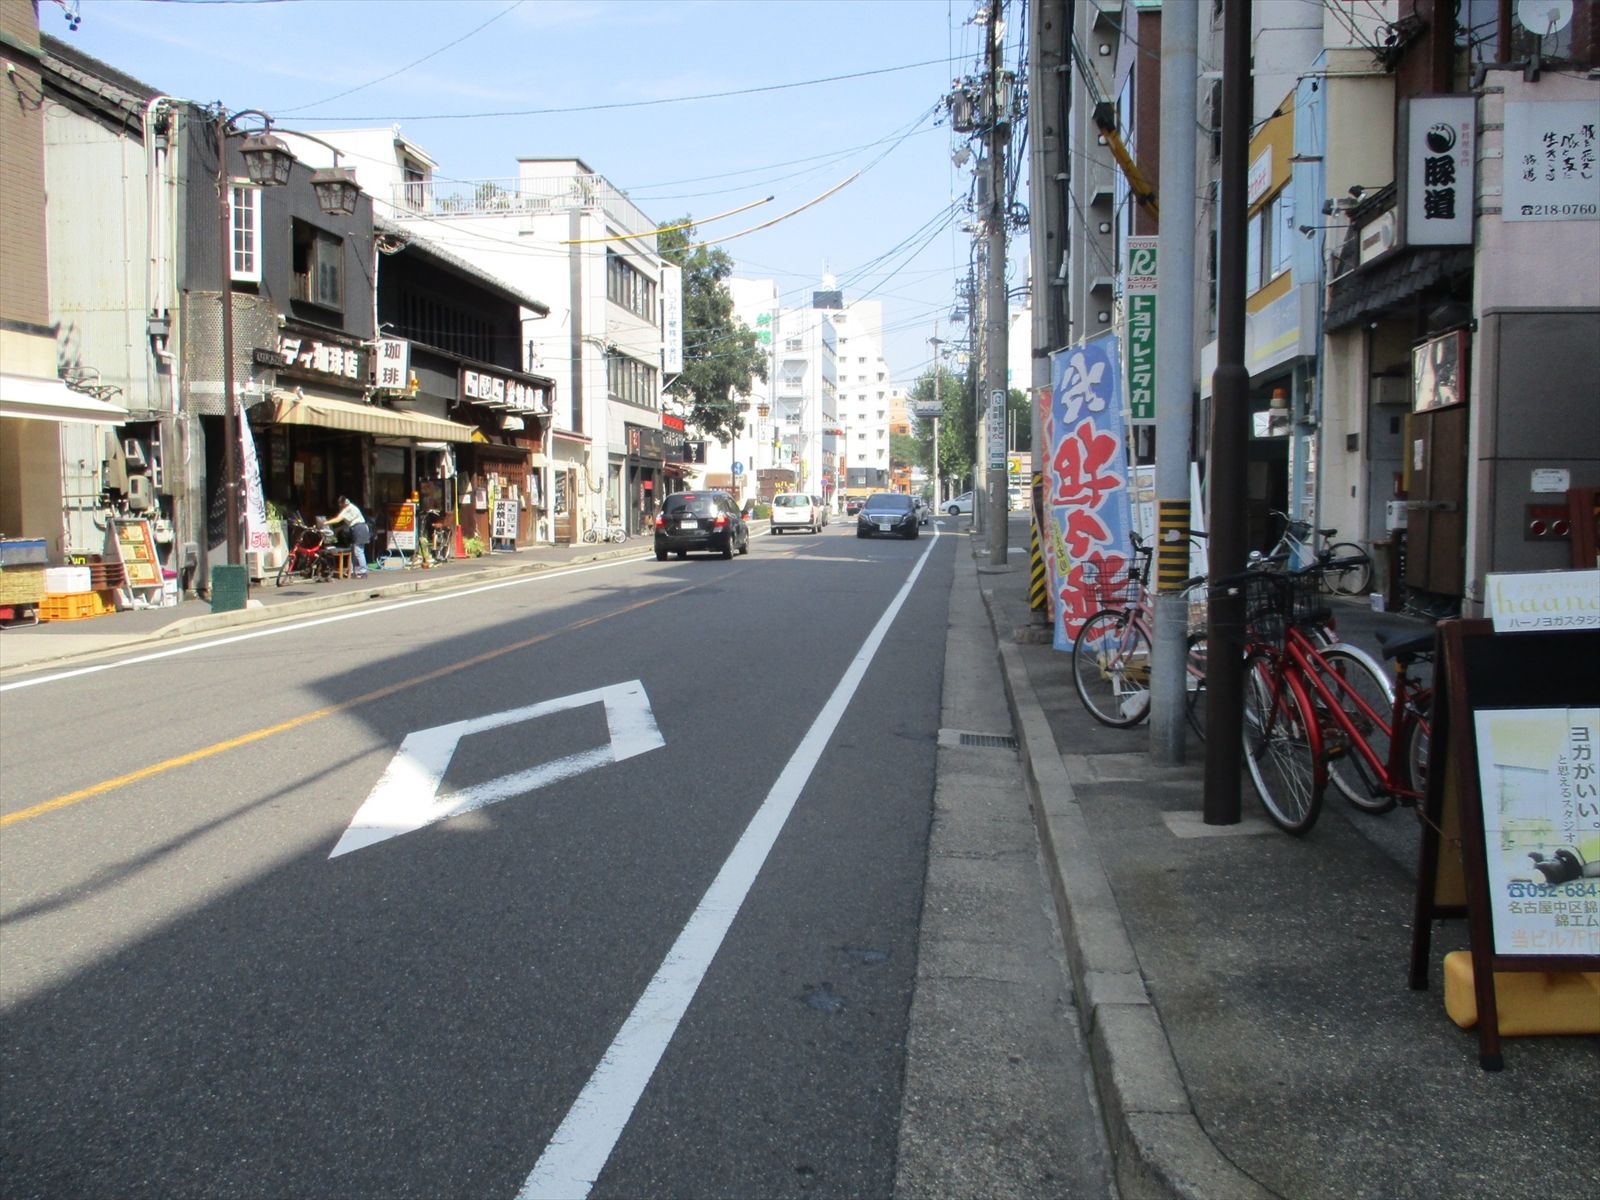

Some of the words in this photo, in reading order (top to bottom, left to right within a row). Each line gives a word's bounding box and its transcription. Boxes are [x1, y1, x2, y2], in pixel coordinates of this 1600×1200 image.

[1424, 154, 1456, 220] 豚道
[277, 335, 358, 379] ディ珈琲店
[383, 342, 400, 385] 珈琲
[1132, 297, 1151, 418] トヨタレンタカー
[1510, 615, 1600, 628] ハーノヨガスタジ
[1508, 901, 1598, 914] 名古屋中区錦
